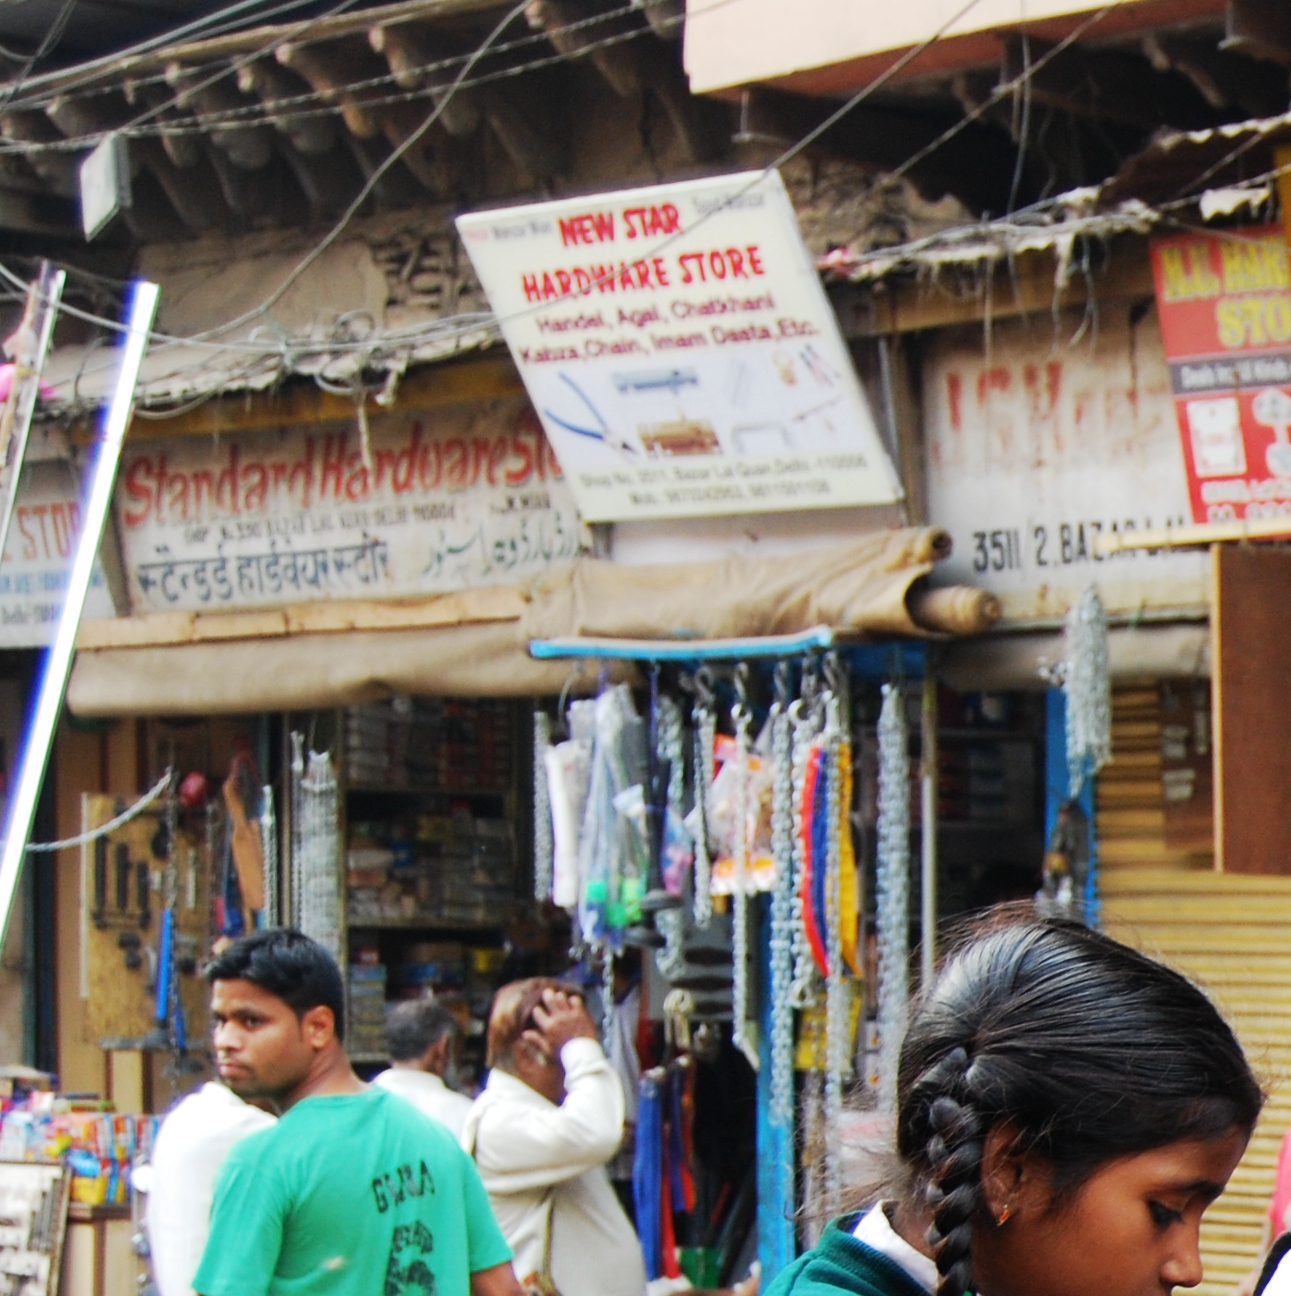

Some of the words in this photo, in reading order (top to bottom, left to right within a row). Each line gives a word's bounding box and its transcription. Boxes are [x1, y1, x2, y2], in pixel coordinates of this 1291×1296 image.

[557, 213, 615, 247] NEW
[622, 202, 682, 240] STAR
[521, 257, 670, 303] HARDWARE
[677, 246, 765, 285] STORE
[124, 432, 314, 527] Standard
